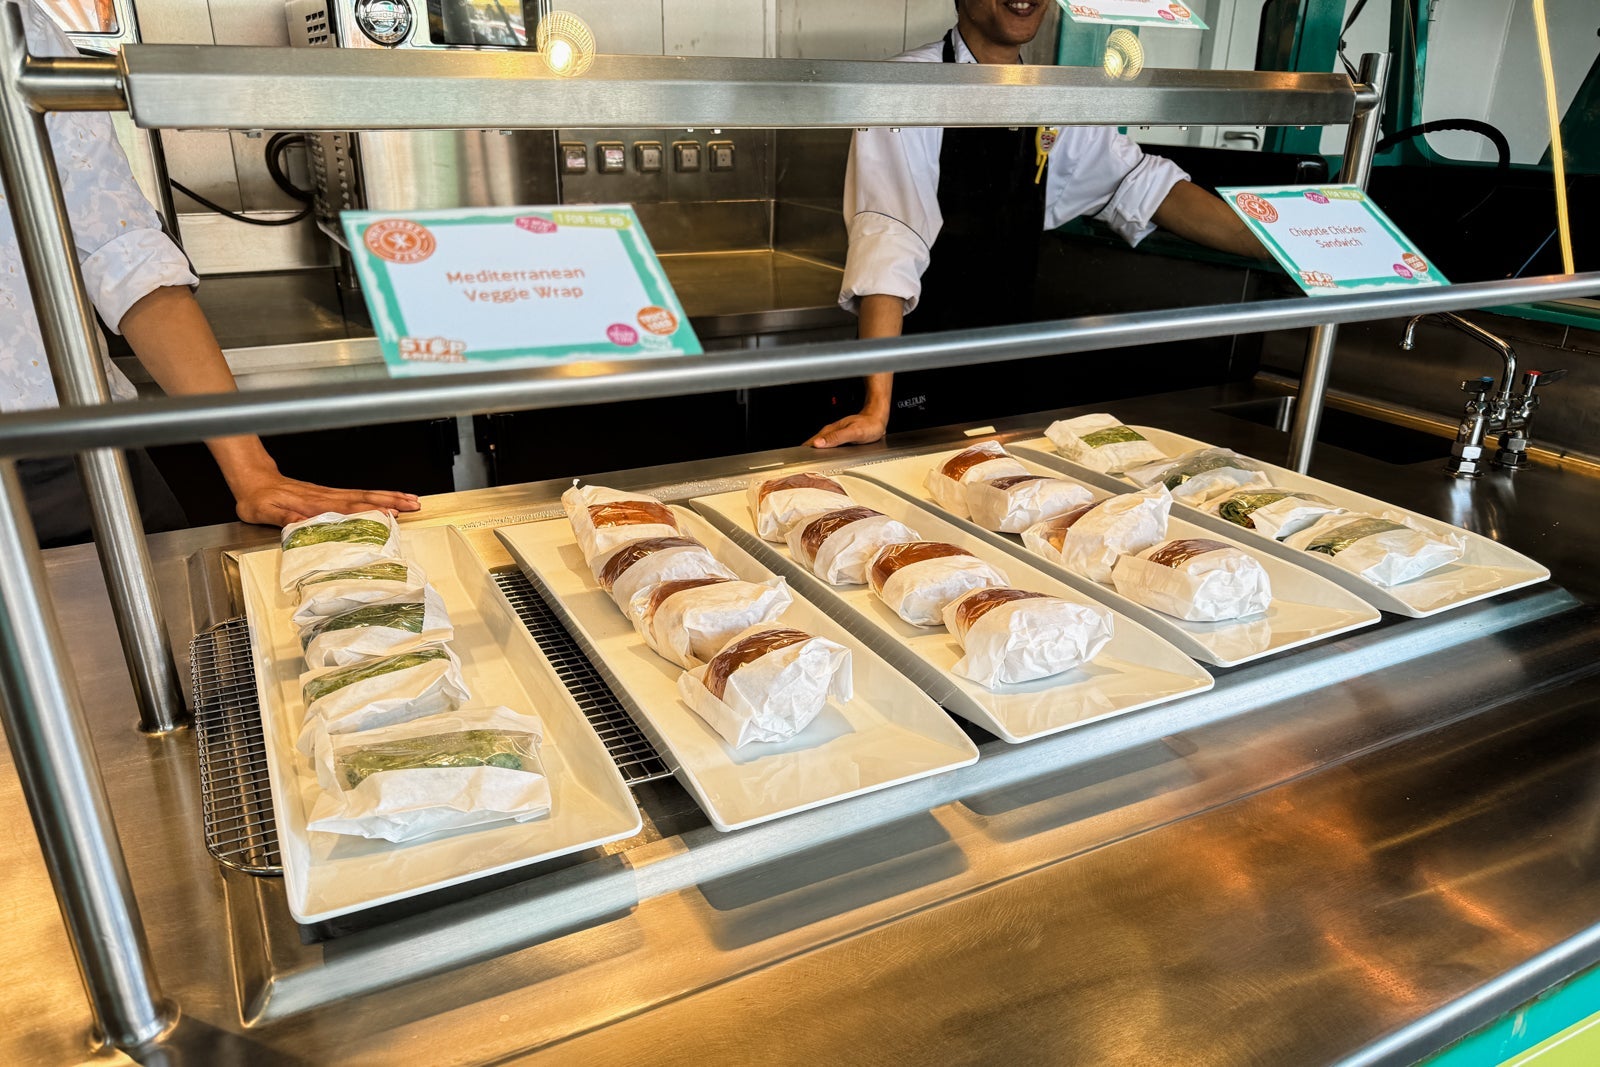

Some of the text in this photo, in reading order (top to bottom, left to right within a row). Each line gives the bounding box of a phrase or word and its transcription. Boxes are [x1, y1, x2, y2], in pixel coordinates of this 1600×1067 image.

[1288, 224, 1366, 237] Chipotle Chicken
[1315, 238, 1363, 249] Sandwich
[446, 267, 585, 284] Mediterranean
[464, 285, 584, 304] Veggie Wrap
[400, 337, 467, 354] STOP
